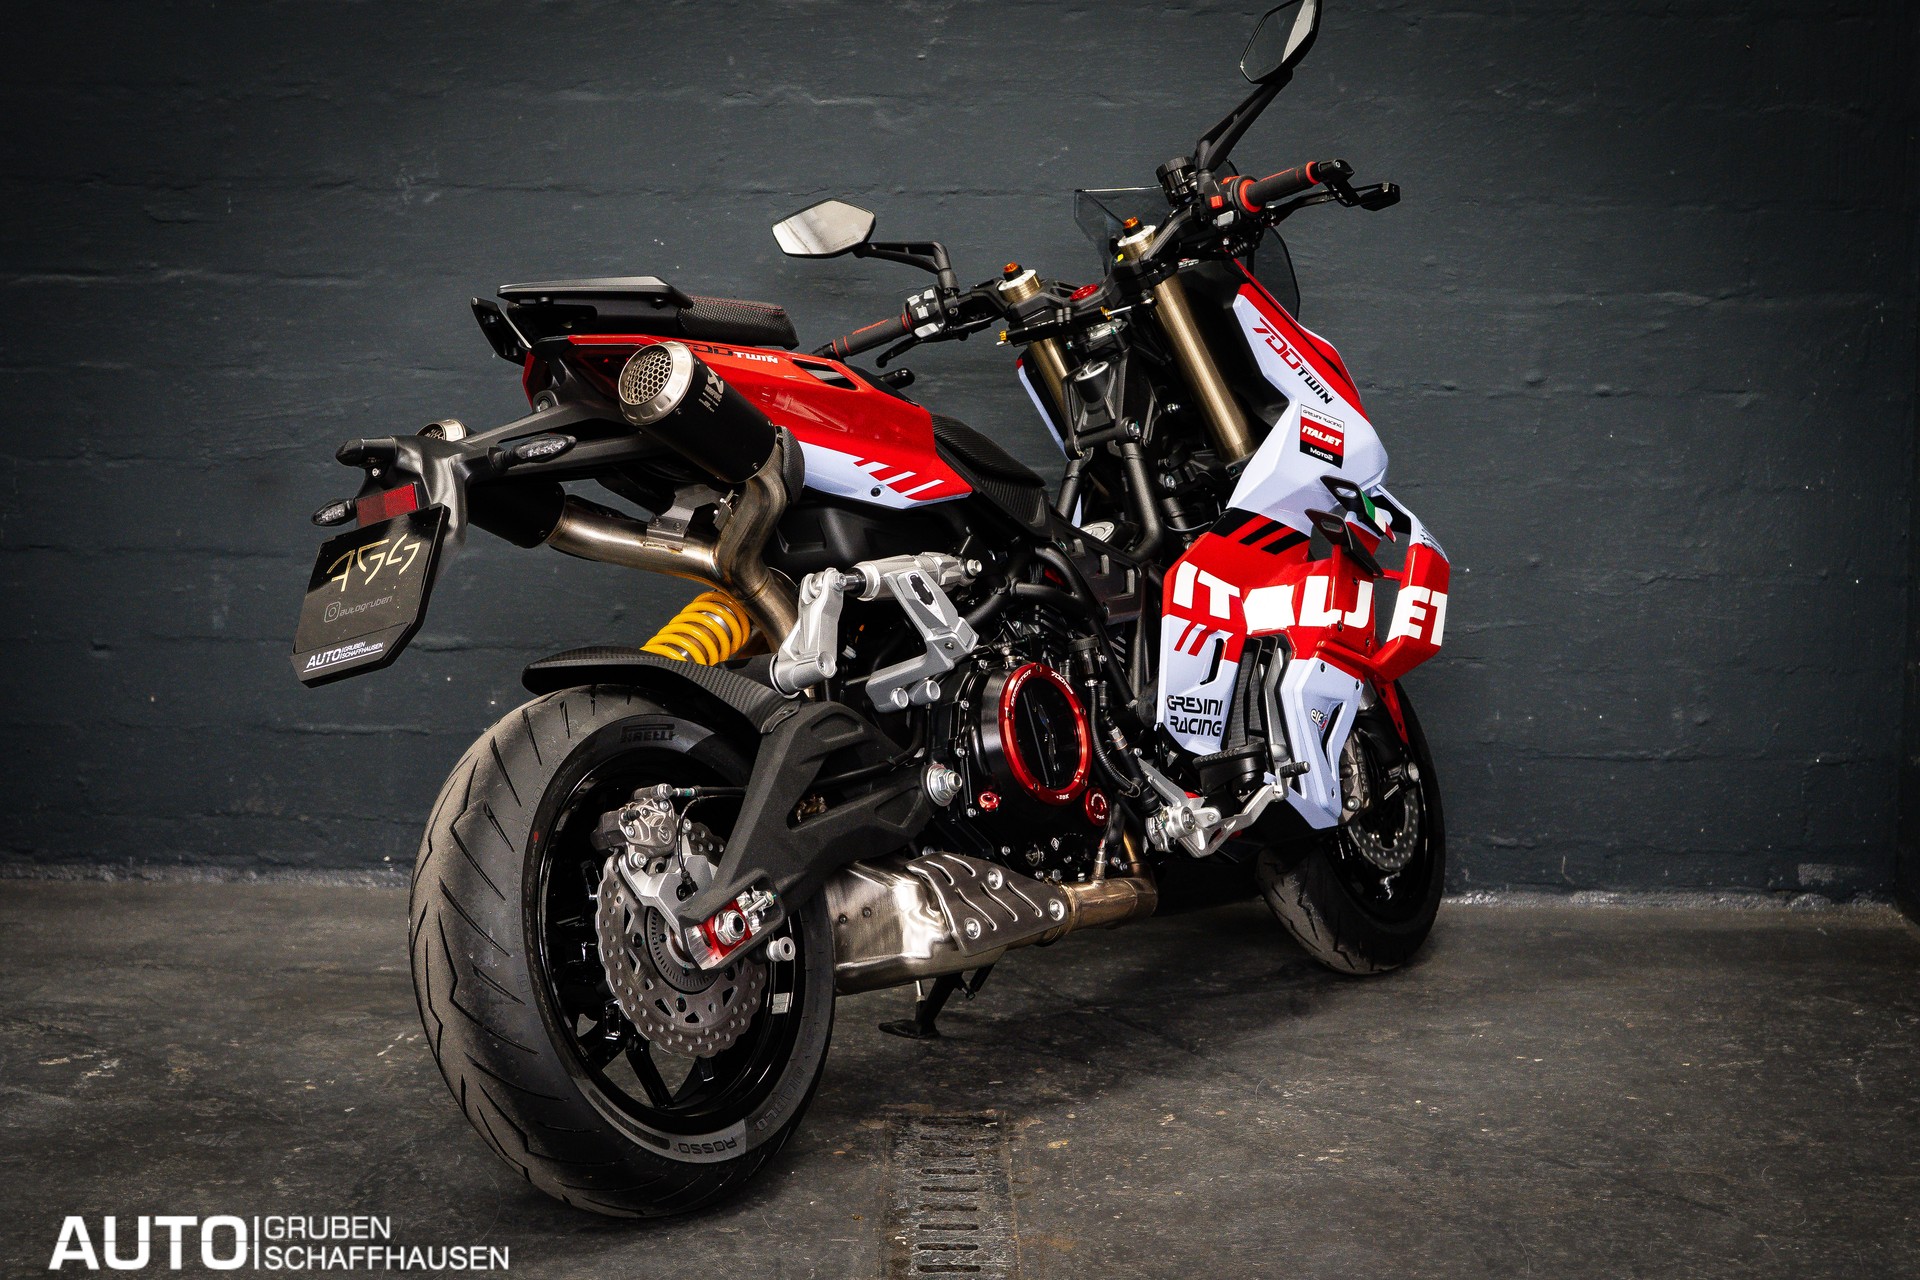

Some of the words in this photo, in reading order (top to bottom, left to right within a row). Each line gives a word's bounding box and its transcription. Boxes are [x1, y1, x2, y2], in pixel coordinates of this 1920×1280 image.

[733, 351, 779, 364] TWIN
[1302, 425, 1342, 447] ITALJET
[1173, 560, 1448, 647] ITALJET
[306, 648, 340, 669] AUTO
[342, 641, 366, 653] GRUBEN
[341, 642, 384, 660] SCHAFFHAUSEN
[1167, 695, 1223, 716] GRESINI
[1169, 716, 1222, 737] RACING
[677, 1136, 738, 1155] ROSSO
